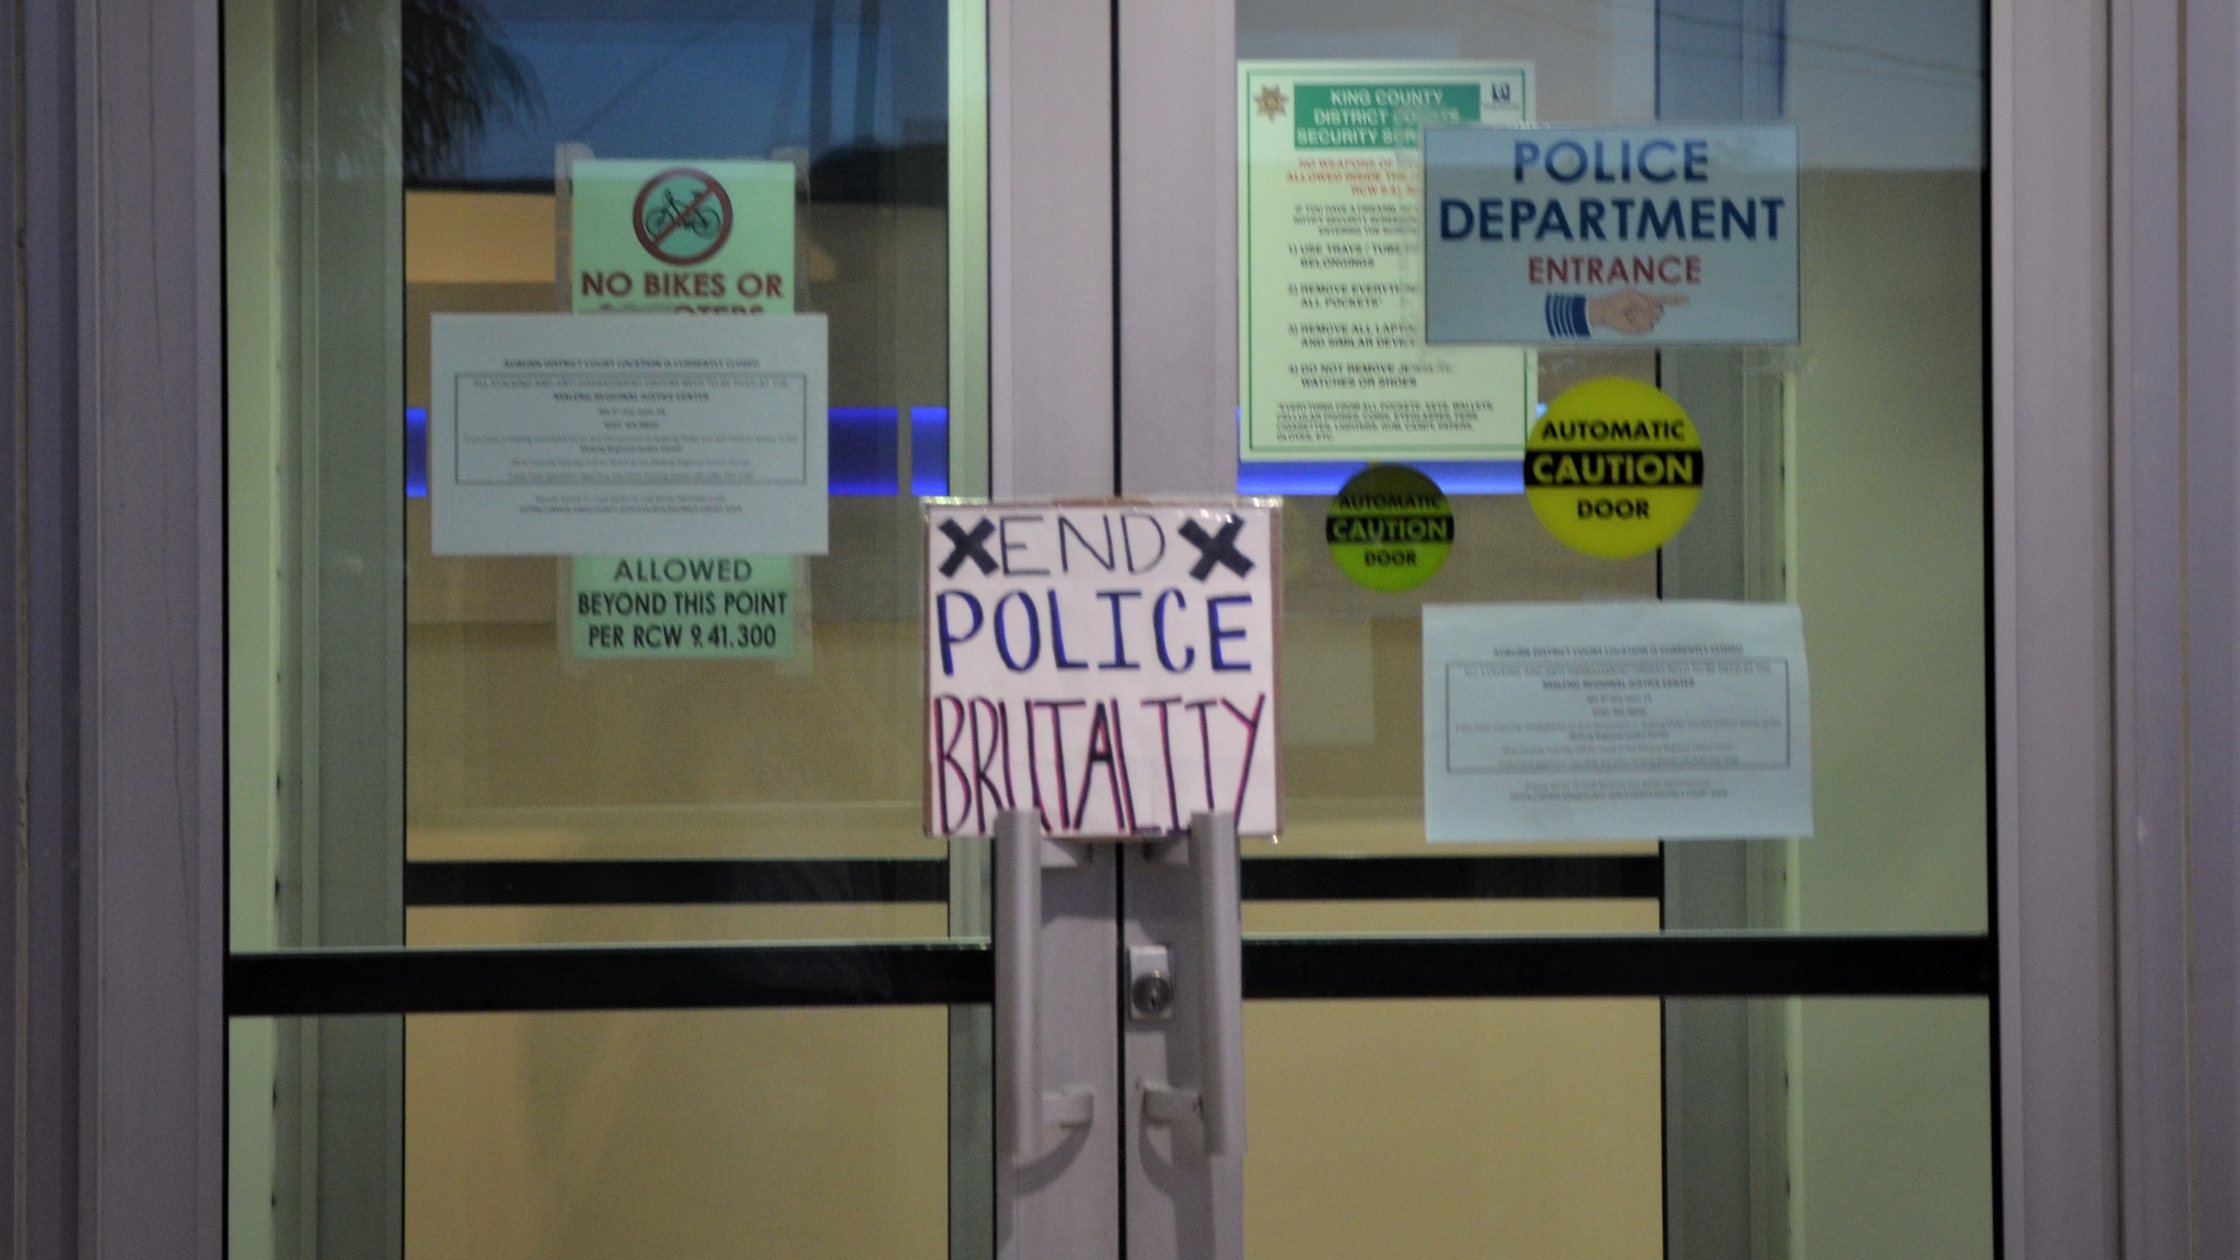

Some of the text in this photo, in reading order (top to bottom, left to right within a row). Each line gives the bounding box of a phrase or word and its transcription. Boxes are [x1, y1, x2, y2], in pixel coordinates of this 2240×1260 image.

[1331, 88, 1443, 106] KING COUNTY
[1314, 108, 1386, 126] DISTRICT
[1296, 127, 1418, 146] SECURITY SCR
[1298, 158, 1315, 170] NO
[1319, 158, 1376, 170] WEAPONS
[1514, 139, 1709, 184] POLICE
[1287, 171, 1342, 183] ALLOWED
[1439, 196, 1785, 242] DEPARTMENT
[1300, 244, 1322, 255] USE
[1326, 244, 1363, 255] TRAYS
[1300, 257, 1375, 269] BELONGINGS
[1527, 255, 1702, 286] ENTRANCE
[581, 271, 785, 298] NO BIKES OR
[1301, 284, 1348, 295] REMOVE
[1301, 298, 1321, 308] ALL
[1301, 323, 1348, 335] REMOVE
[1351, 323, 1373, 335] ALL
[1301, 337, 1325, 348] AND
[1328, 337, 1374, 348] SIMILAR
[1301, 363, 1318, 375] DO
[1321, 363, 1343, 375] NOT
[1347, 363, 1394, 375] REMOVE
[1301, 377, 1417, 388] WATCHES OR SHOES
[1542, 420, 1685, 442] AUTOMATIC
[1532, 453, 1694, 485] CAUTION
[1339, 495, 1441, 511] AUTOMATIC
[1578, 499, 1651, 520] DOOR
[1332, 518, 1448, 542] CAUTION
[1000, 514, 1166, 577] END
[1364, 550, 1417, 567] DOOR
[614, 557, 753, 583] ALLOWED
[577, 591, 788, 616] BEYOND THIS POINT
[588, 623, 624, 648] PER
[633, 623, 683, 648] RCW
[936, 588, 1254, 677] POLICE
[934, 693, 1266, 837] BRUTALITY
